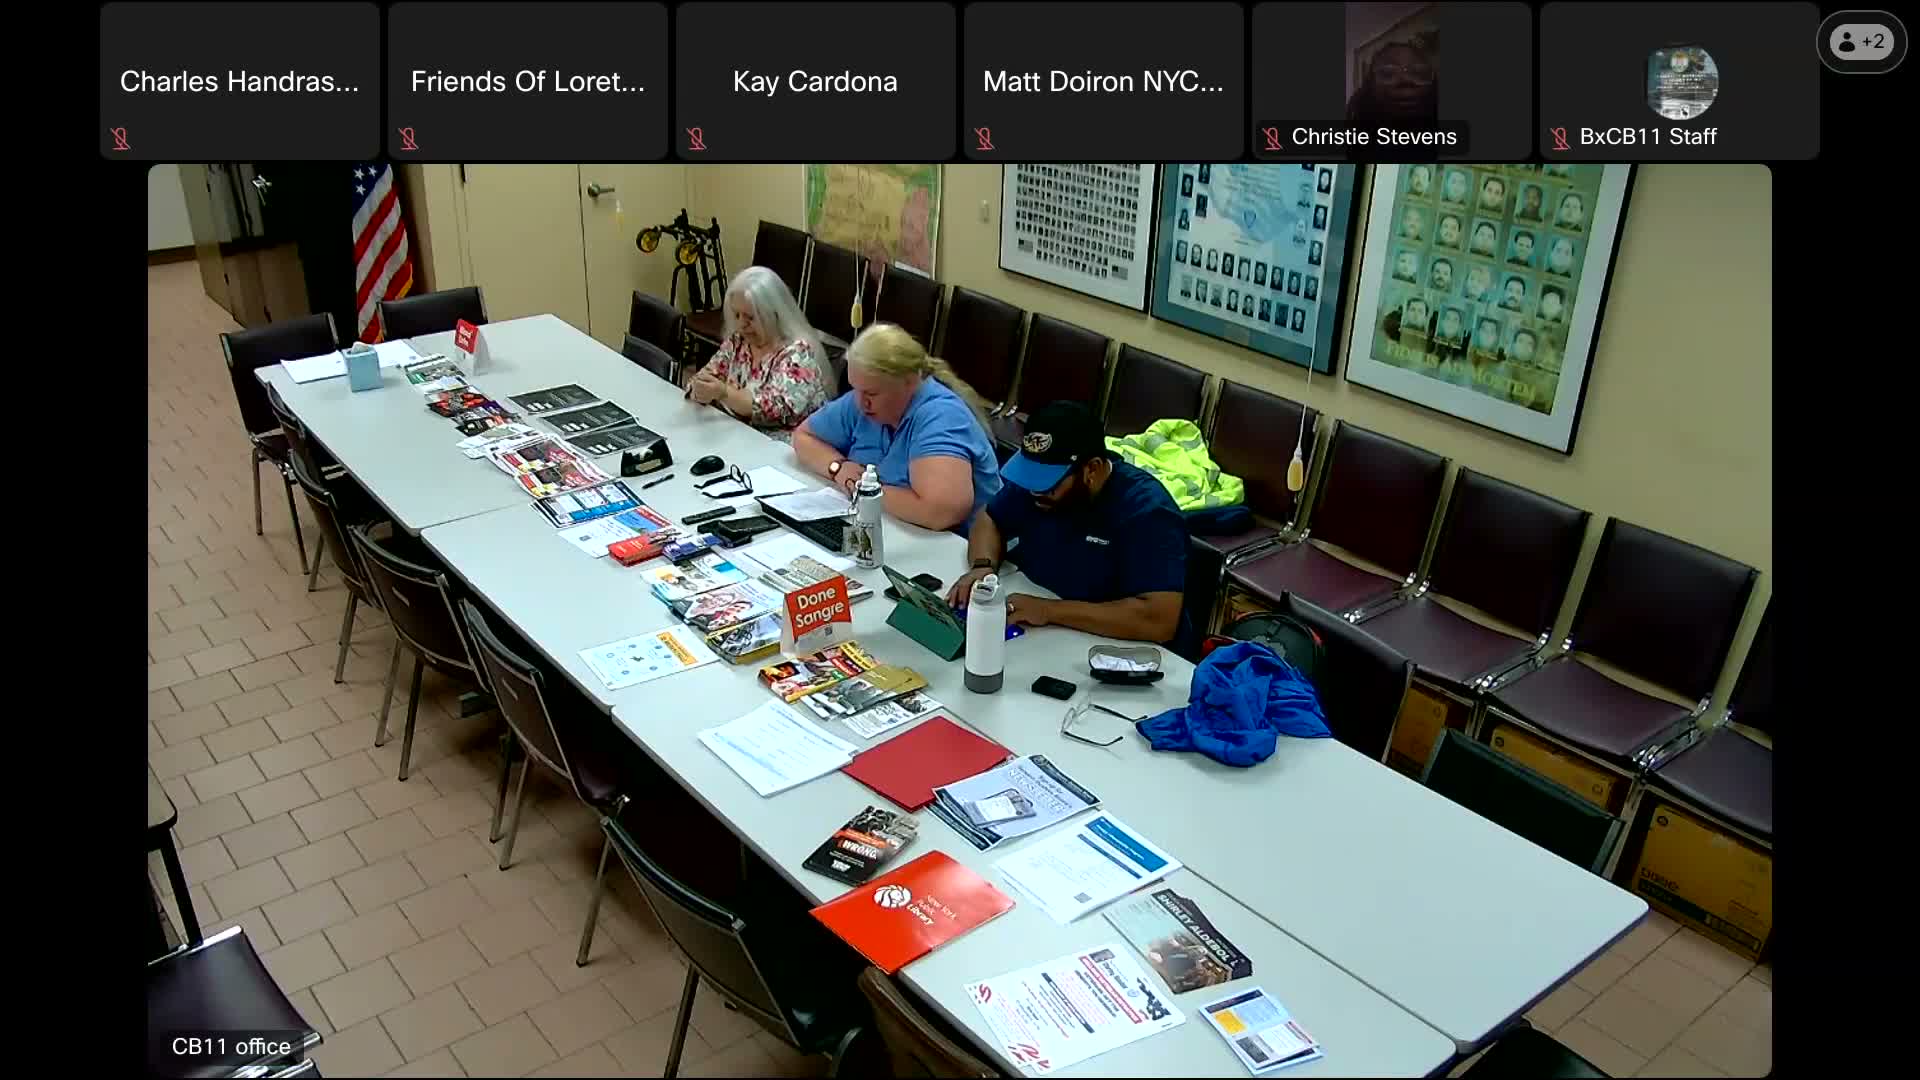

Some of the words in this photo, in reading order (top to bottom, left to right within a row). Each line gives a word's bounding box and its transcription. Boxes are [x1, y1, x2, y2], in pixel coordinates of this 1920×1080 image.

[797, 588, 836, 609] Done
[795, 602, 844, 628] Sangre
[906, 904, 934, 925] Library
[1157, 894, 1194, 924] SHIRLEY
[1189, 924, 1229, 961] ALDEBOL
